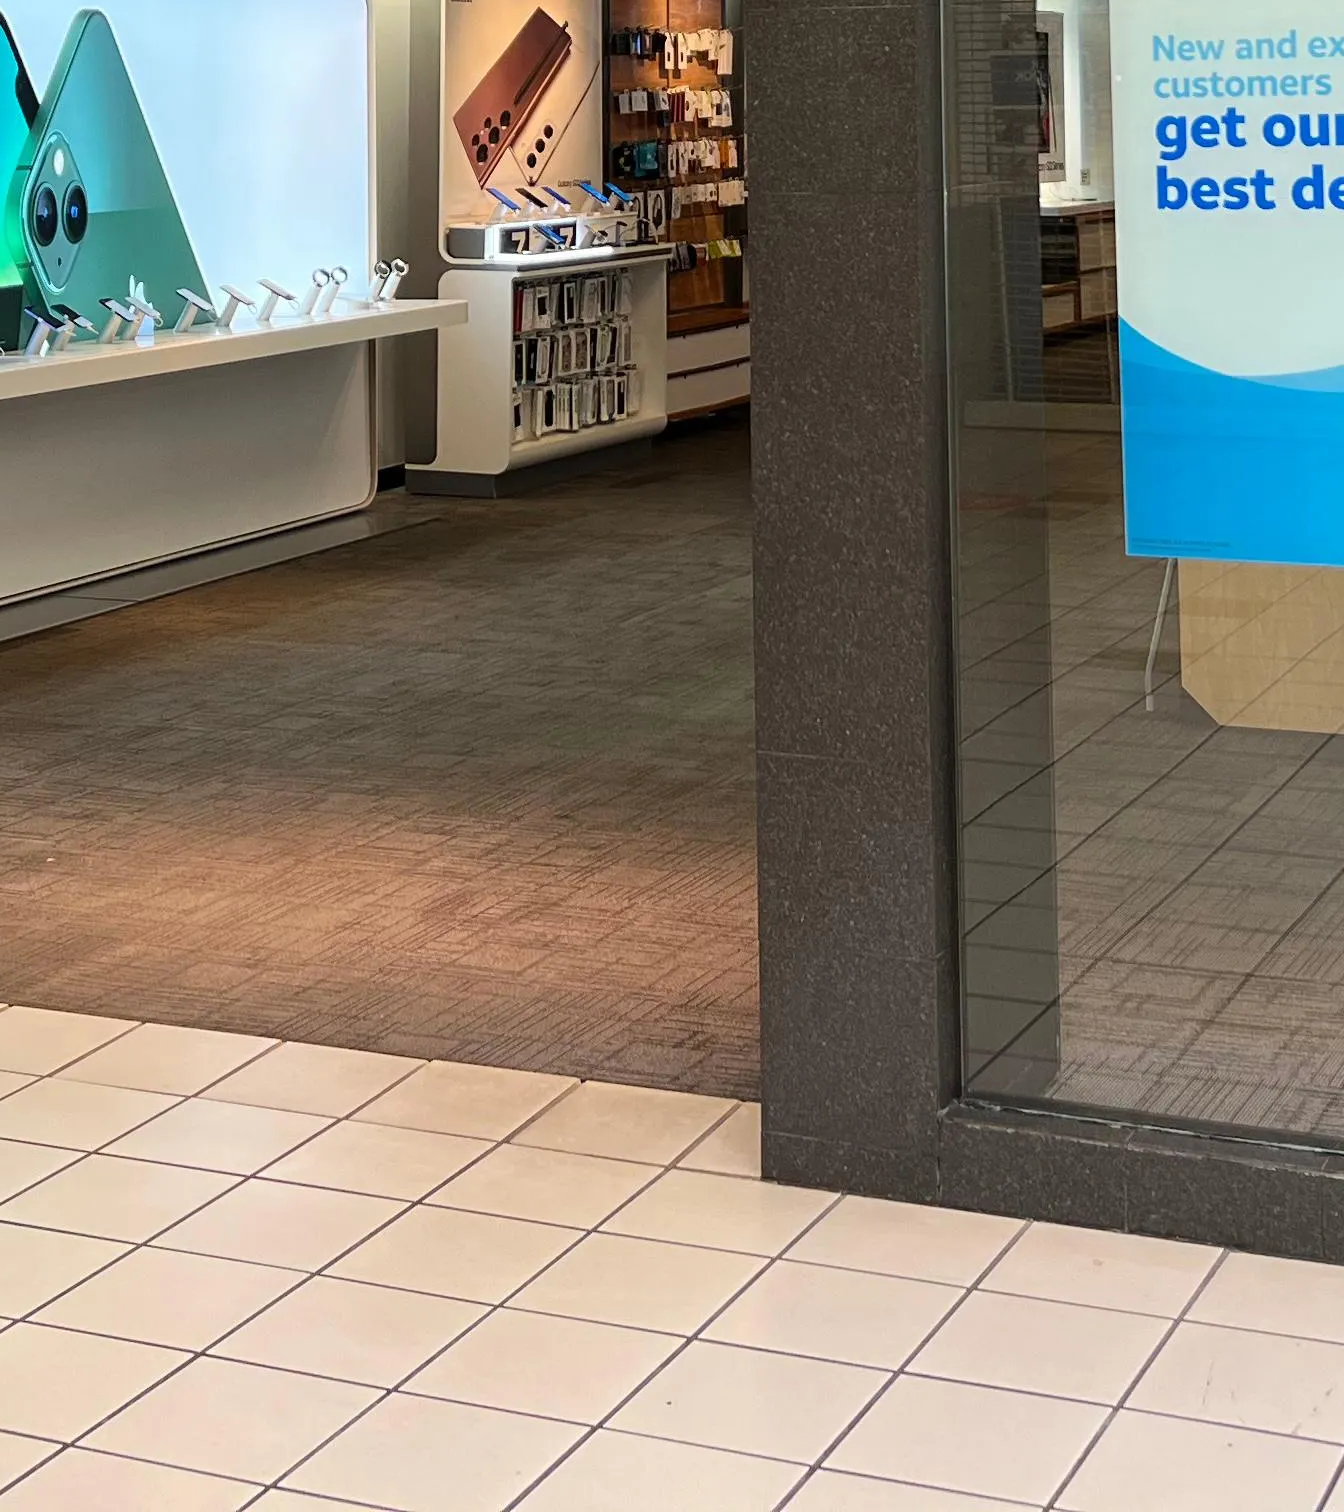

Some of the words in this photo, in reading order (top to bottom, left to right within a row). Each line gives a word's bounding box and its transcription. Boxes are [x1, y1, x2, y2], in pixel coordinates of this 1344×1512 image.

[1152, 35, 1224, 61] New
[1235, 29, 1297, 60] and
[1153, 72, 1332, 98] customers
[1155, 107, 1247, 161] get
[1156, 165, 1276, 210] best
